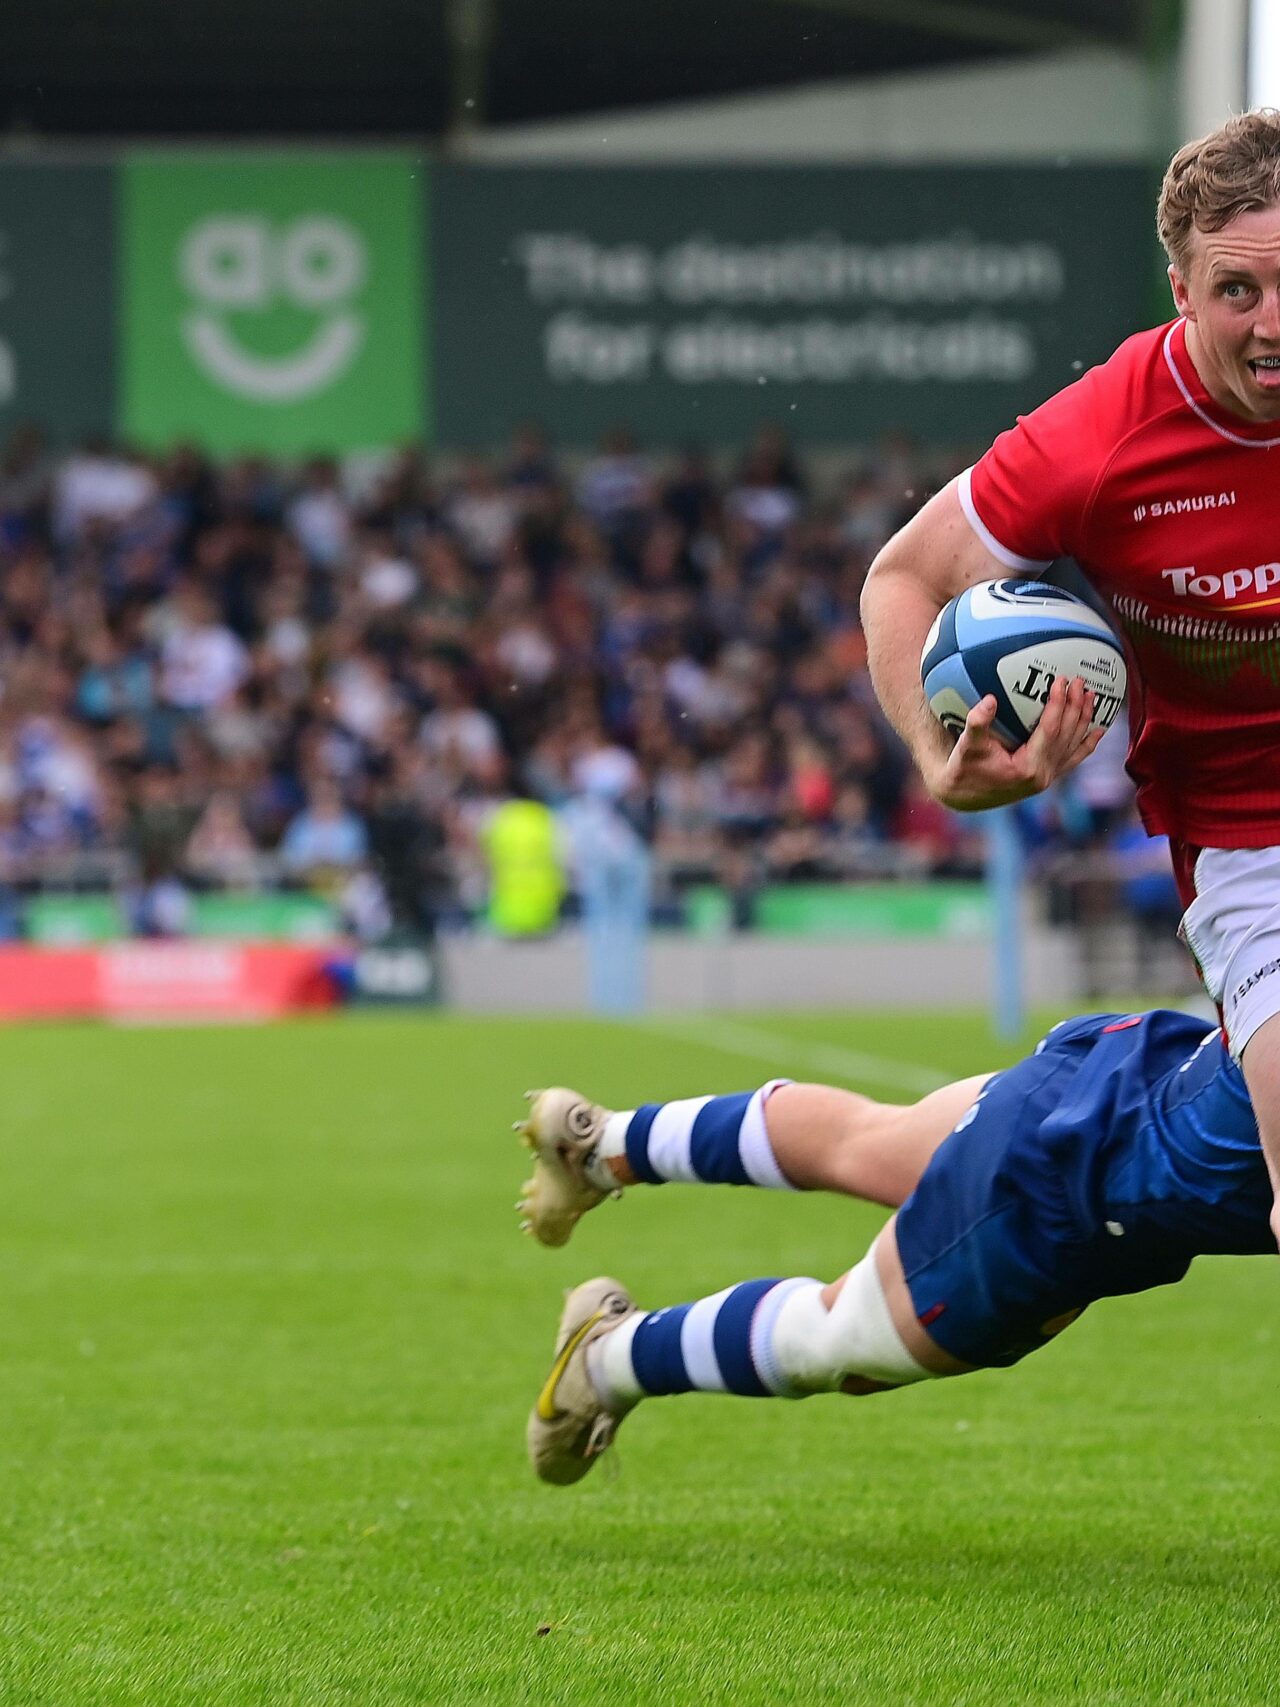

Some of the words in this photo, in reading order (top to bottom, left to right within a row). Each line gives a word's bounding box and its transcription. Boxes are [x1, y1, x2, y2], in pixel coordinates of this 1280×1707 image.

[179, 212, 367, 309] ao
[520, 231, 652, 301] The
[661, 229, 1065, 301] destination
[544, 310, 650, 381] for
[663, 310, 1034, 381] electricals
[1150, 491, 1236, 517] SAMURAI
